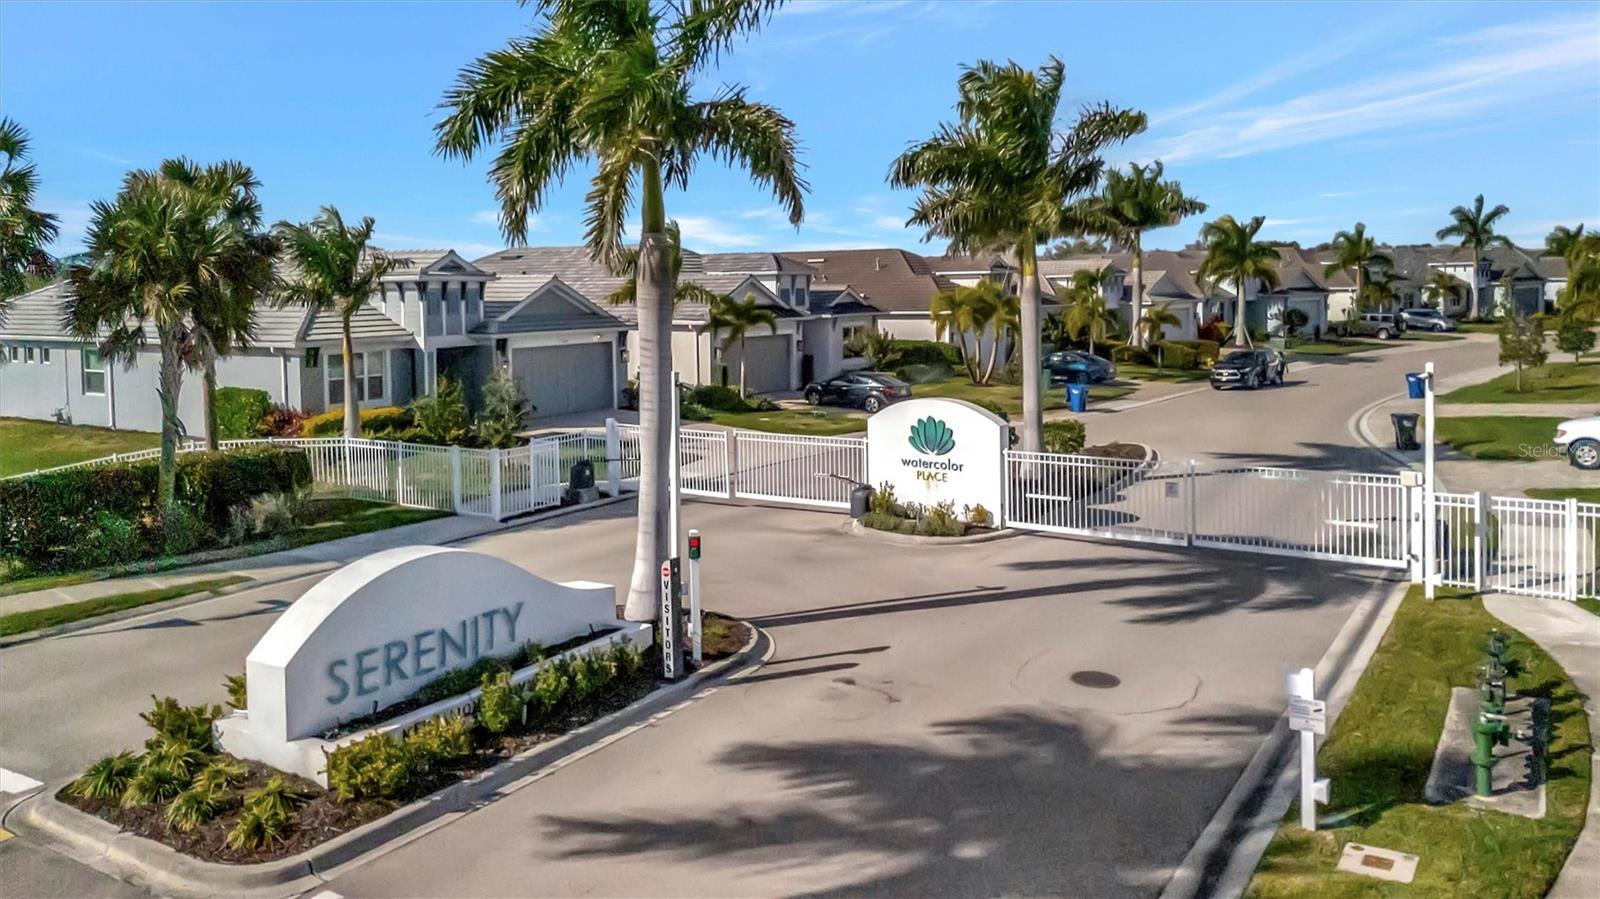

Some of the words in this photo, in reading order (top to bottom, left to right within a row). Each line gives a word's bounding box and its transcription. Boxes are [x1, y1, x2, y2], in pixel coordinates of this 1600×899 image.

[901, 458, 964, 472] watercolor
[916, 470, 948, 483] PLACE
[325, 601, 525, 706] SERENITY
[663, 580, 673, 674] VISITORS
